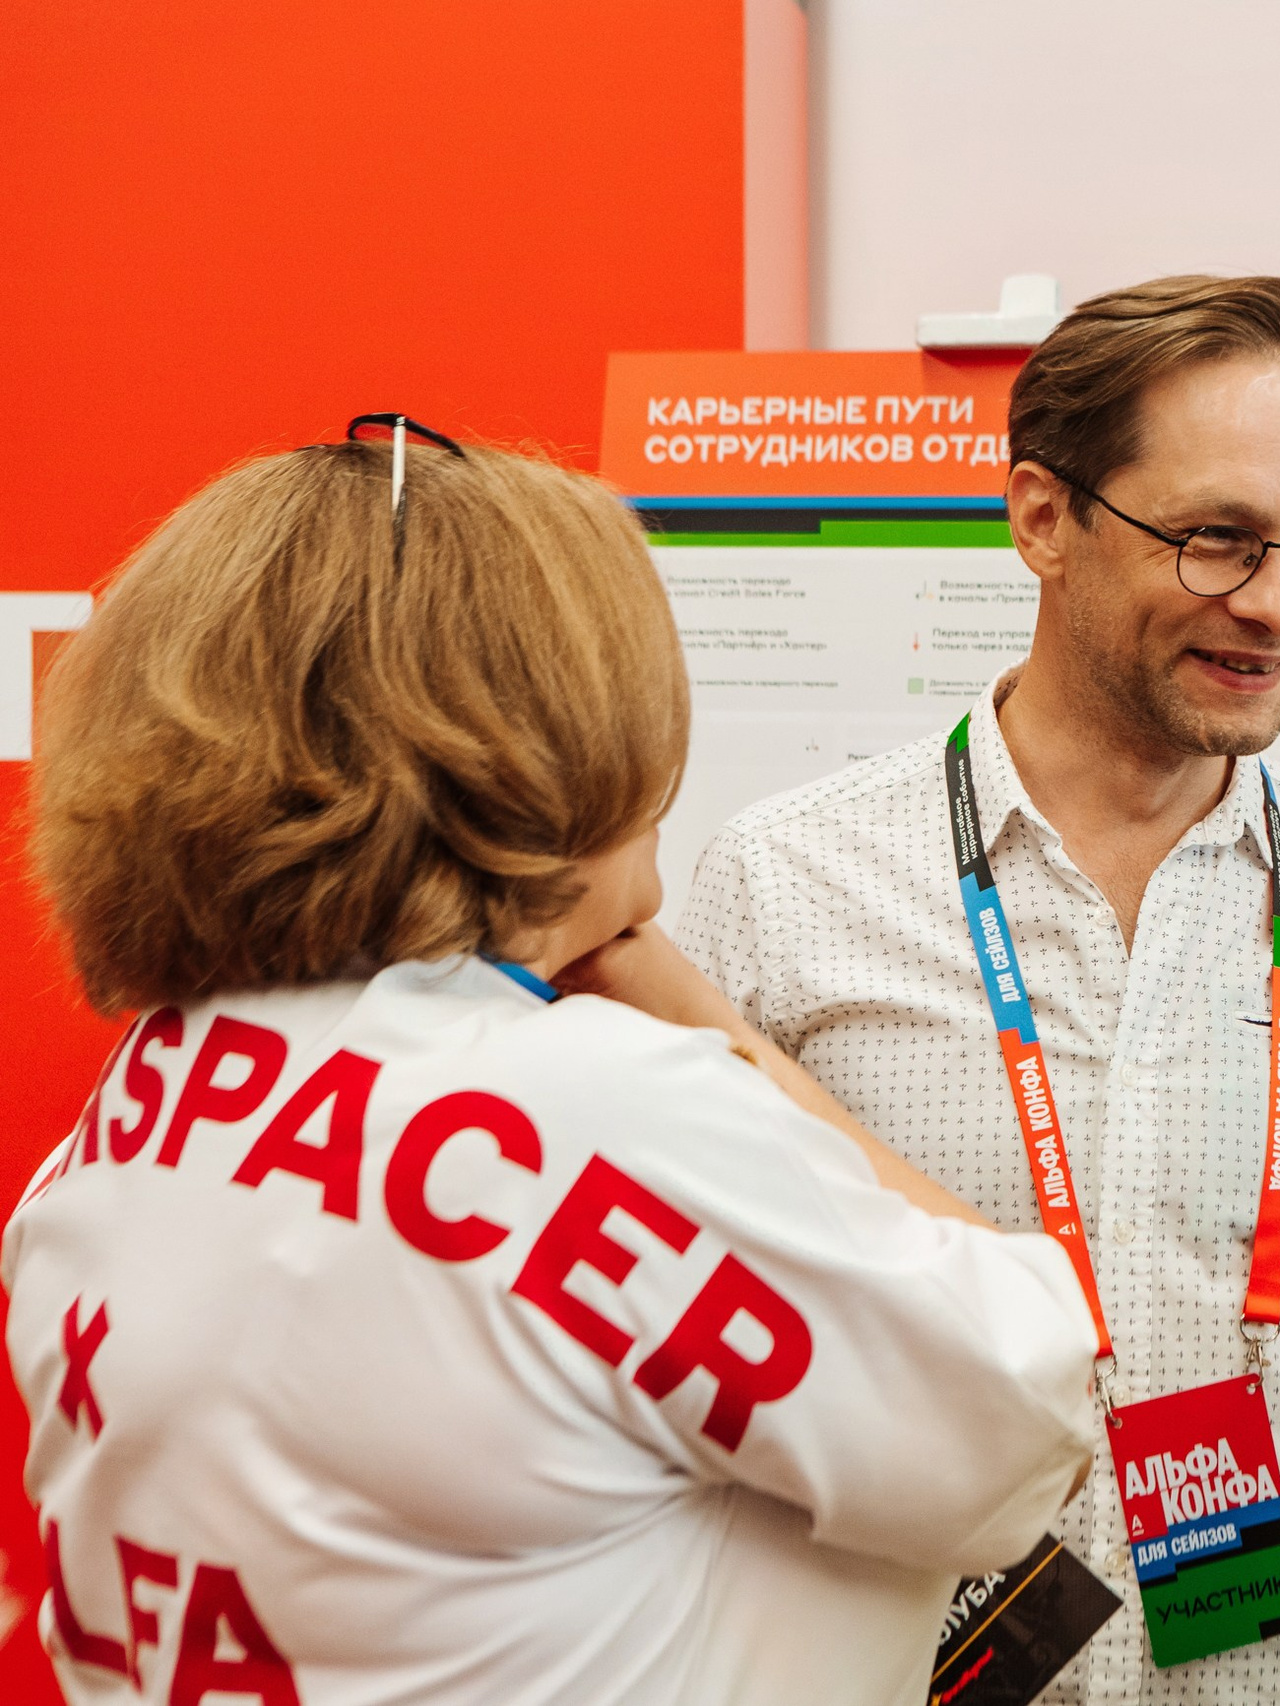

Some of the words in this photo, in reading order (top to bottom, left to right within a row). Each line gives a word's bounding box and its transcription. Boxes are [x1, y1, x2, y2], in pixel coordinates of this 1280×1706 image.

[647, 396, 867, 426] КАРЬЕРНЫЕ
[875, 396, 975, 425] ПУТИ
[643, 434, 914, 467] СОТРУДНИКОВ
[922, 434, 1011, 467] ОТДЕ
[999, 630, 1031, 641] управ
[958, 759, 969, 803] событие
[955, 796, 970, 866] Масштабное
[963, 802, 979, 860] карьерное
[978, 907, 1011, 971] СЕЙЛЗОВ
[996, 972, 1022, 1004] ДЛЯ
[1016, 1055, 1053, 1131] КОНФА
[1035, 1133, 1071, 1208] АЛЬФА
[60, 1005, 814, 1455] SPACER
[1125, 1437, 1240, 1500] АЛЬФА
[1160, 1463, 1280, 1527] КОНФА
[1137, 1541, 1168, 1568] ДЛЯ
[1170, 1523, 1238, 1557] СЕЙЛЗОВ
[44, 1517, 305, 1706] LFA
[938, 1570, 1007, 1647] ЛУБА
